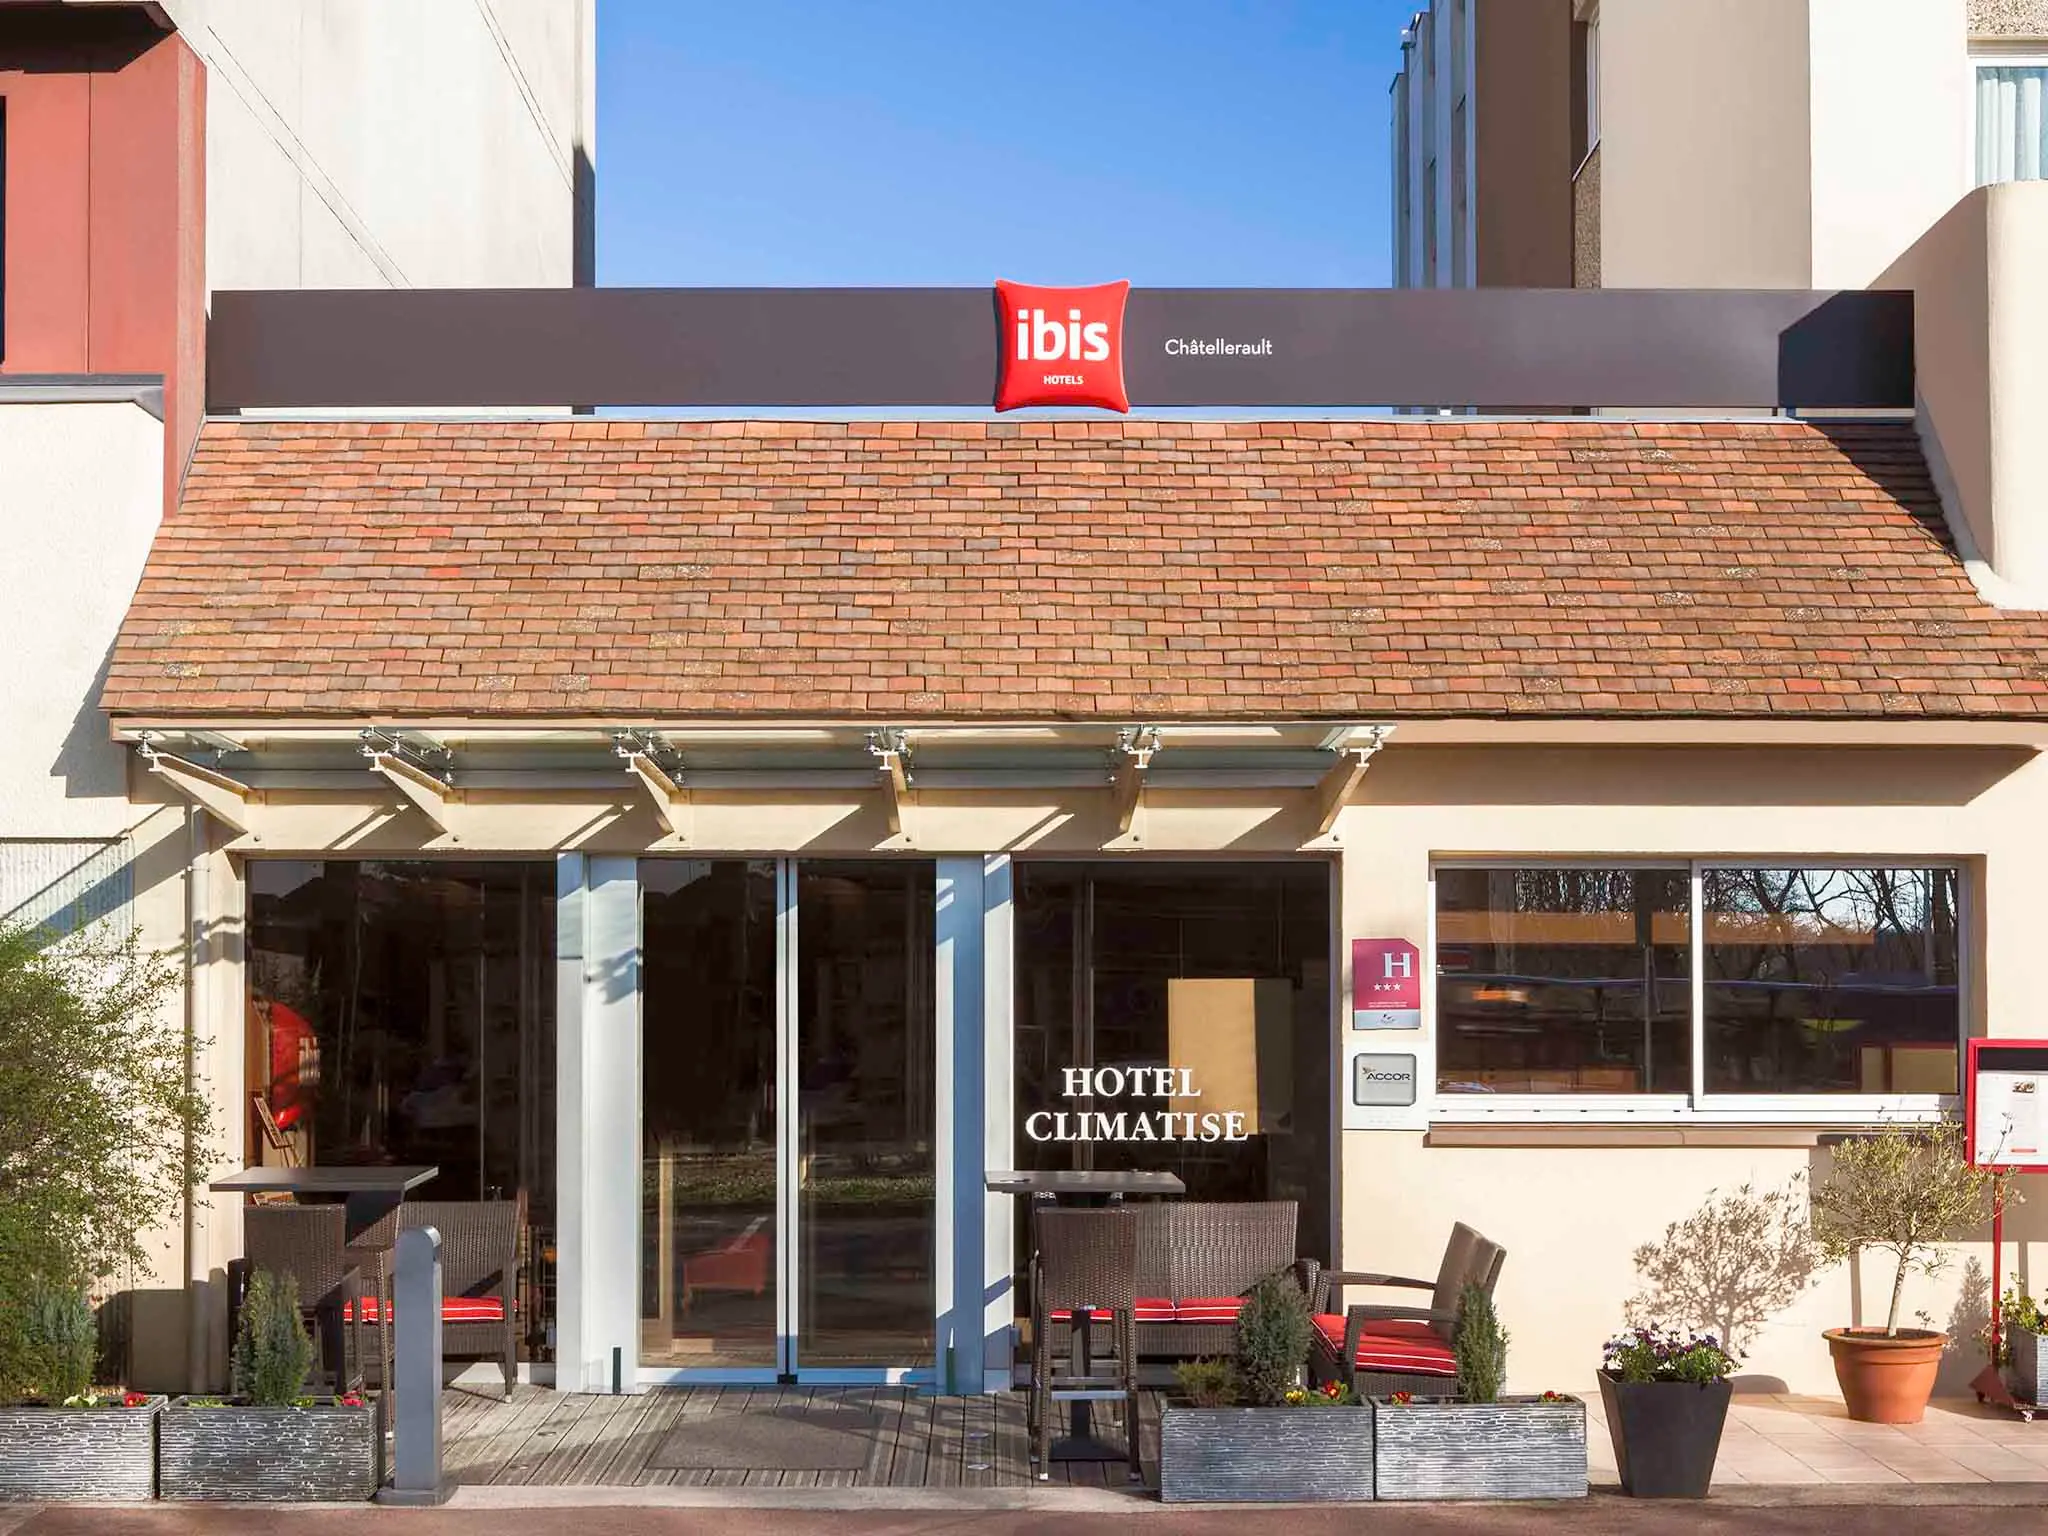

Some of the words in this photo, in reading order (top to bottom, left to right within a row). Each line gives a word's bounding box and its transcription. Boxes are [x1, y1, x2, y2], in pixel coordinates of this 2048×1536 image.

[1017, 309, 1109, 361] ibis
[1165, 338, 1273, 356] Châtellerault
[1043, 375, 1084, 385] HOTELS
[1382, 951, 1414, 978] H
[1061, 1066, 1201, 1097] HOTEL
[1366, 1072, 1411, 1081] ACCOR
[1025, 1110, 1249, 1143] CLIMATISE
